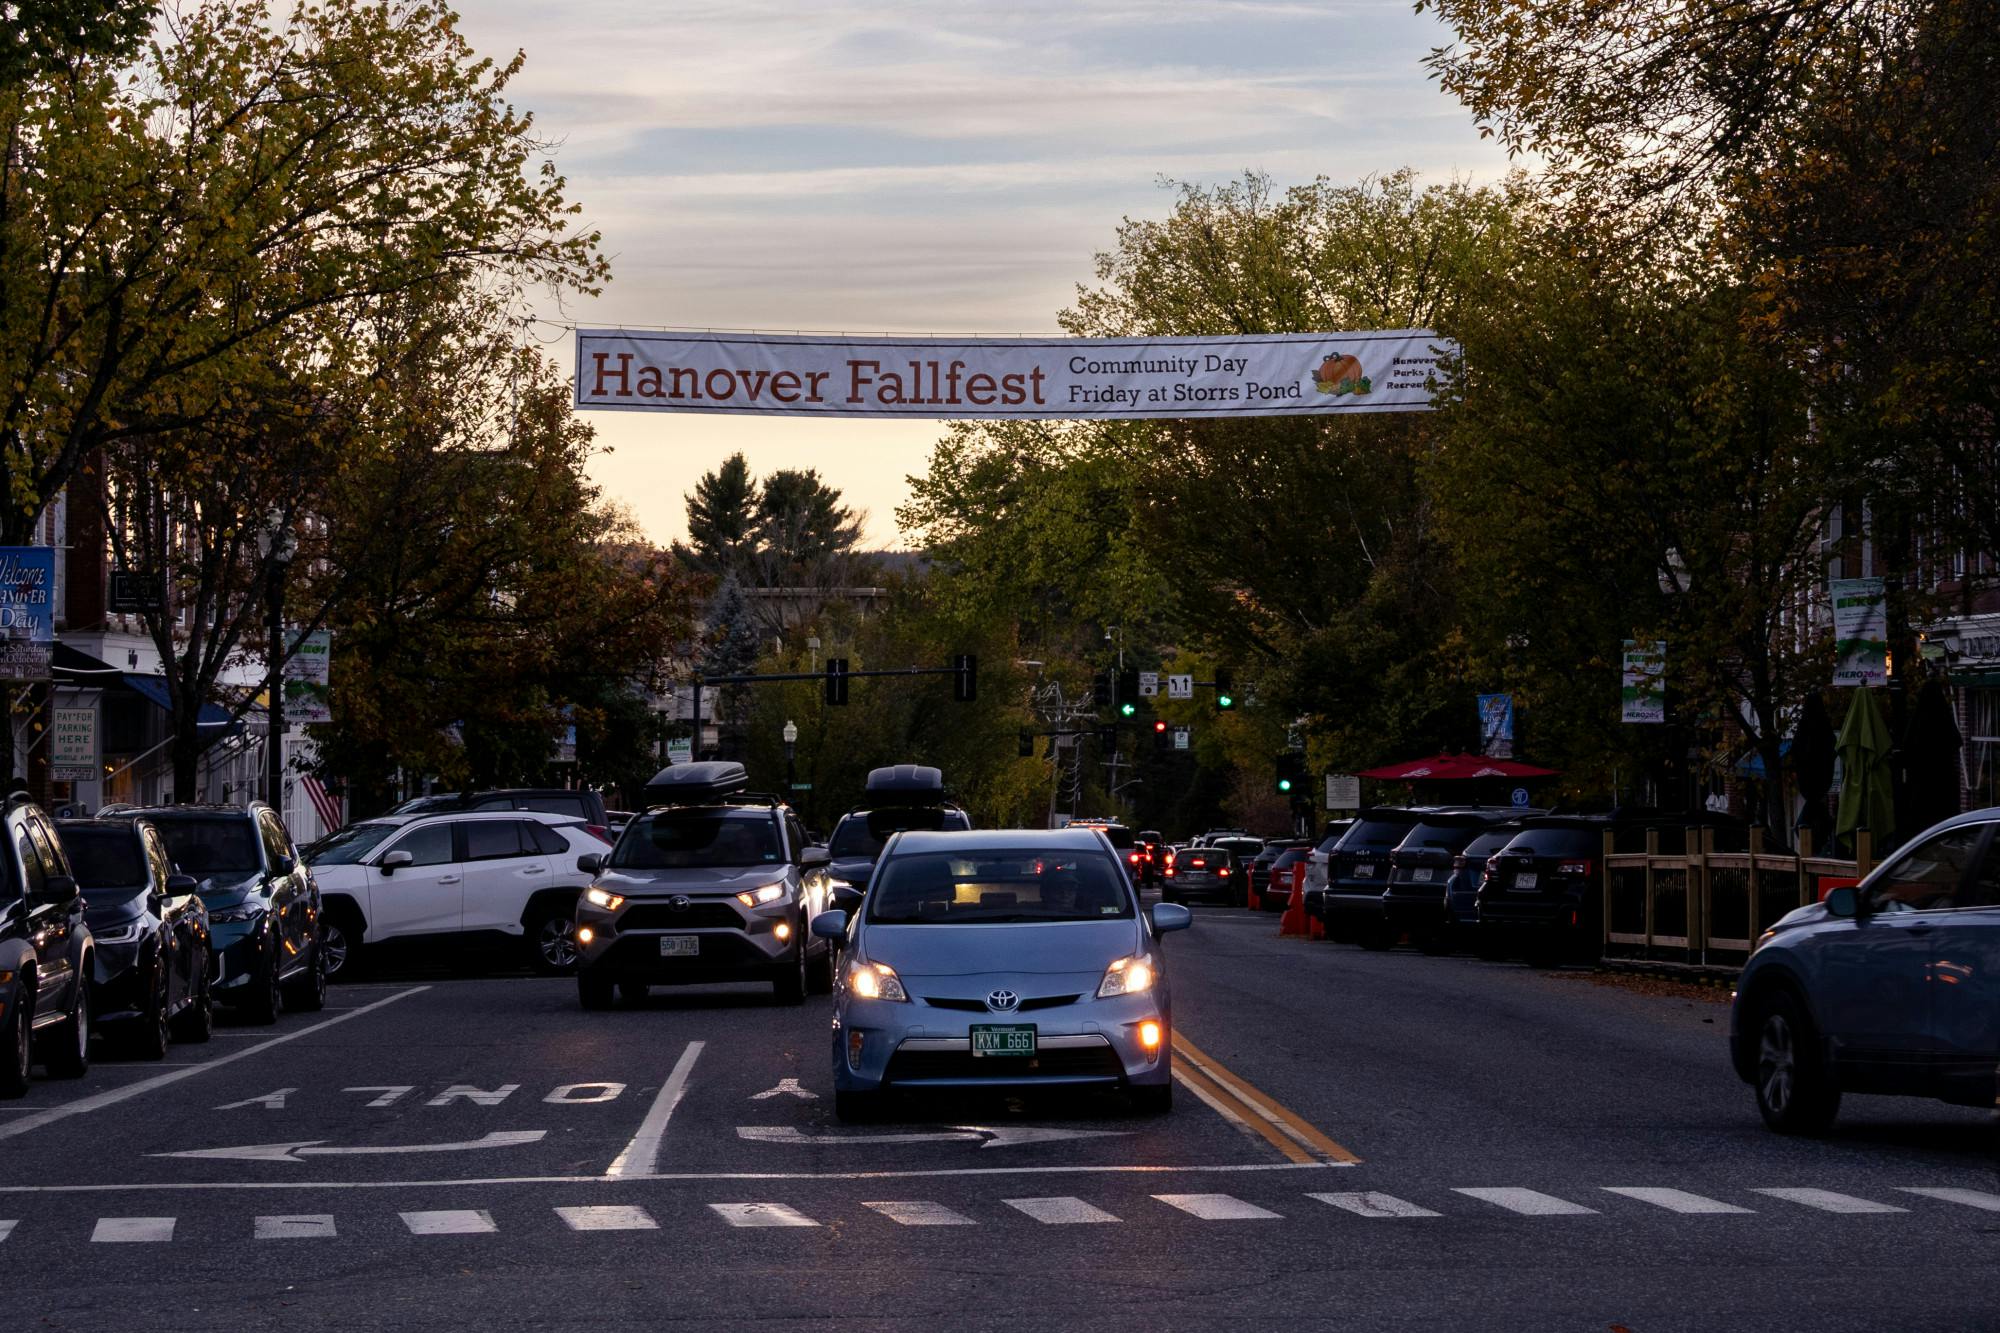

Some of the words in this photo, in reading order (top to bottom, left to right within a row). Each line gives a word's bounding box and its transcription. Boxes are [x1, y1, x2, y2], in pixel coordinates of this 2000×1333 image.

[1069, 356, 1199, 377] Community
[1204, 354, 1248, 376] Day
[1393, 369, 1424, 377] Parks
[1428, 368, 1436, 376] &
[591, 352, 829, 403] Hanover
[846, 359, 1046, 405] Fallfest
[1069, 385, 1141, 407] Friday
[1148, 386, 1168, 402] at
[1174, 384, 1239, 402] Storrs
[1246, 381, 1302, 400] Pond
[0, 607, 39, 637] Day
[76, 713, 93, 721] FOR
[57, 724, 92, 732] PARKING
[59, 735, 89, 743] HERE
[979, 1034, 1000, 1048] KXM
[1008, 1034, 1028, 1048] 666
